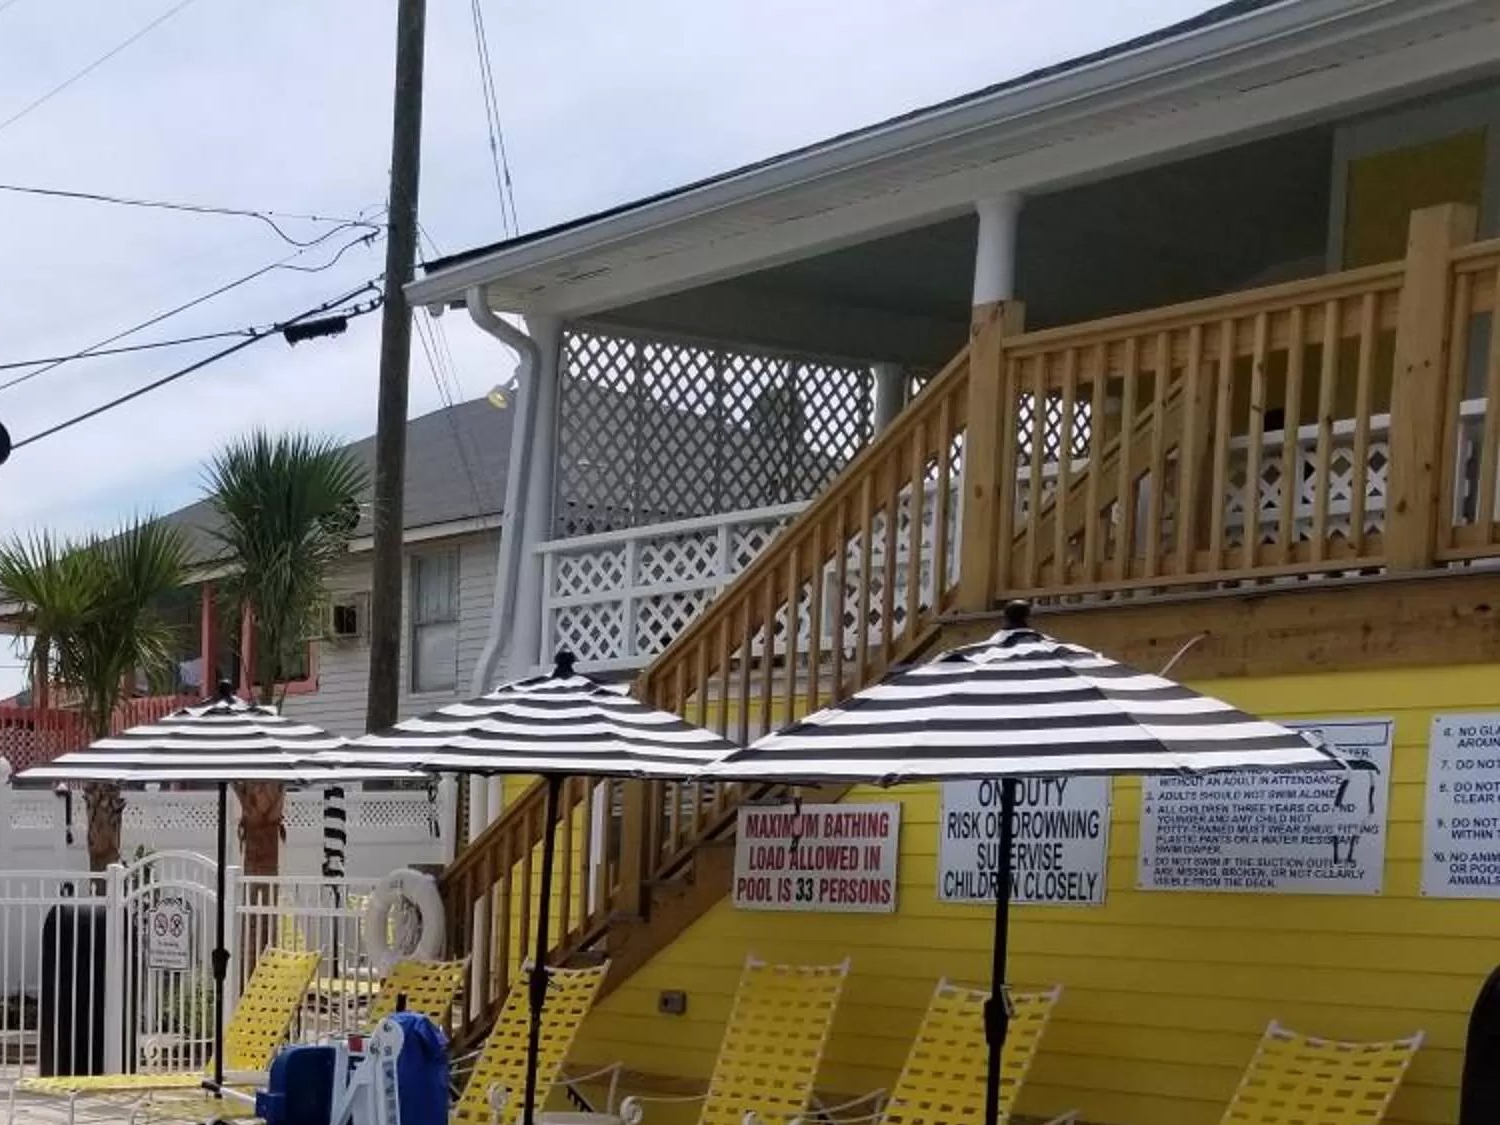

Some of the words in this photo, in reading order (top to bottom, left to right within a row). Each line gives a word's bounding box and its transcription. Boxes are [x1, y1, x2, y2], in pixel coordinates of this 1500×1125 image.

[1459, 726, 1477, 737] NO
[1456, 759, 1474, 770] DO
[1013, 777, 1068, 807] DUTY
[1454, 781, 1472, 793] DO
[1475, 781, 1500, 793] NOT
[1453, 793, 1495, 805] CLEAR
[823, 811, 890, 839] BATHING
[948, 811, 981, 839] RISK
[1010, 810, 1100, 839] DROWNING
[1451, 817, 1470, 829] DO
[1473, 817, 1499, 828] NOT
[1451, 829, 1493, 840] WITHIN
[749, 845, 785, 871] LOAD
[789, 845, 859, 871] ALLOWED
[864, 845, 882, 872] IN
[977, 842, 1063, 871] SUERVISE
[1449, 851, 1468, 862] NO
[1449, 863, 1467, 875] OR
[737, 877, 773, 902] POOL
[777, 877, 793, 903] IS
[795, 877, 814, 902] 33
[819, 878, 892, 904] PERSONS
[944, 870, 1020, 898] CHILDRN
[1024, 872, 1099, 900] CLOSELY
